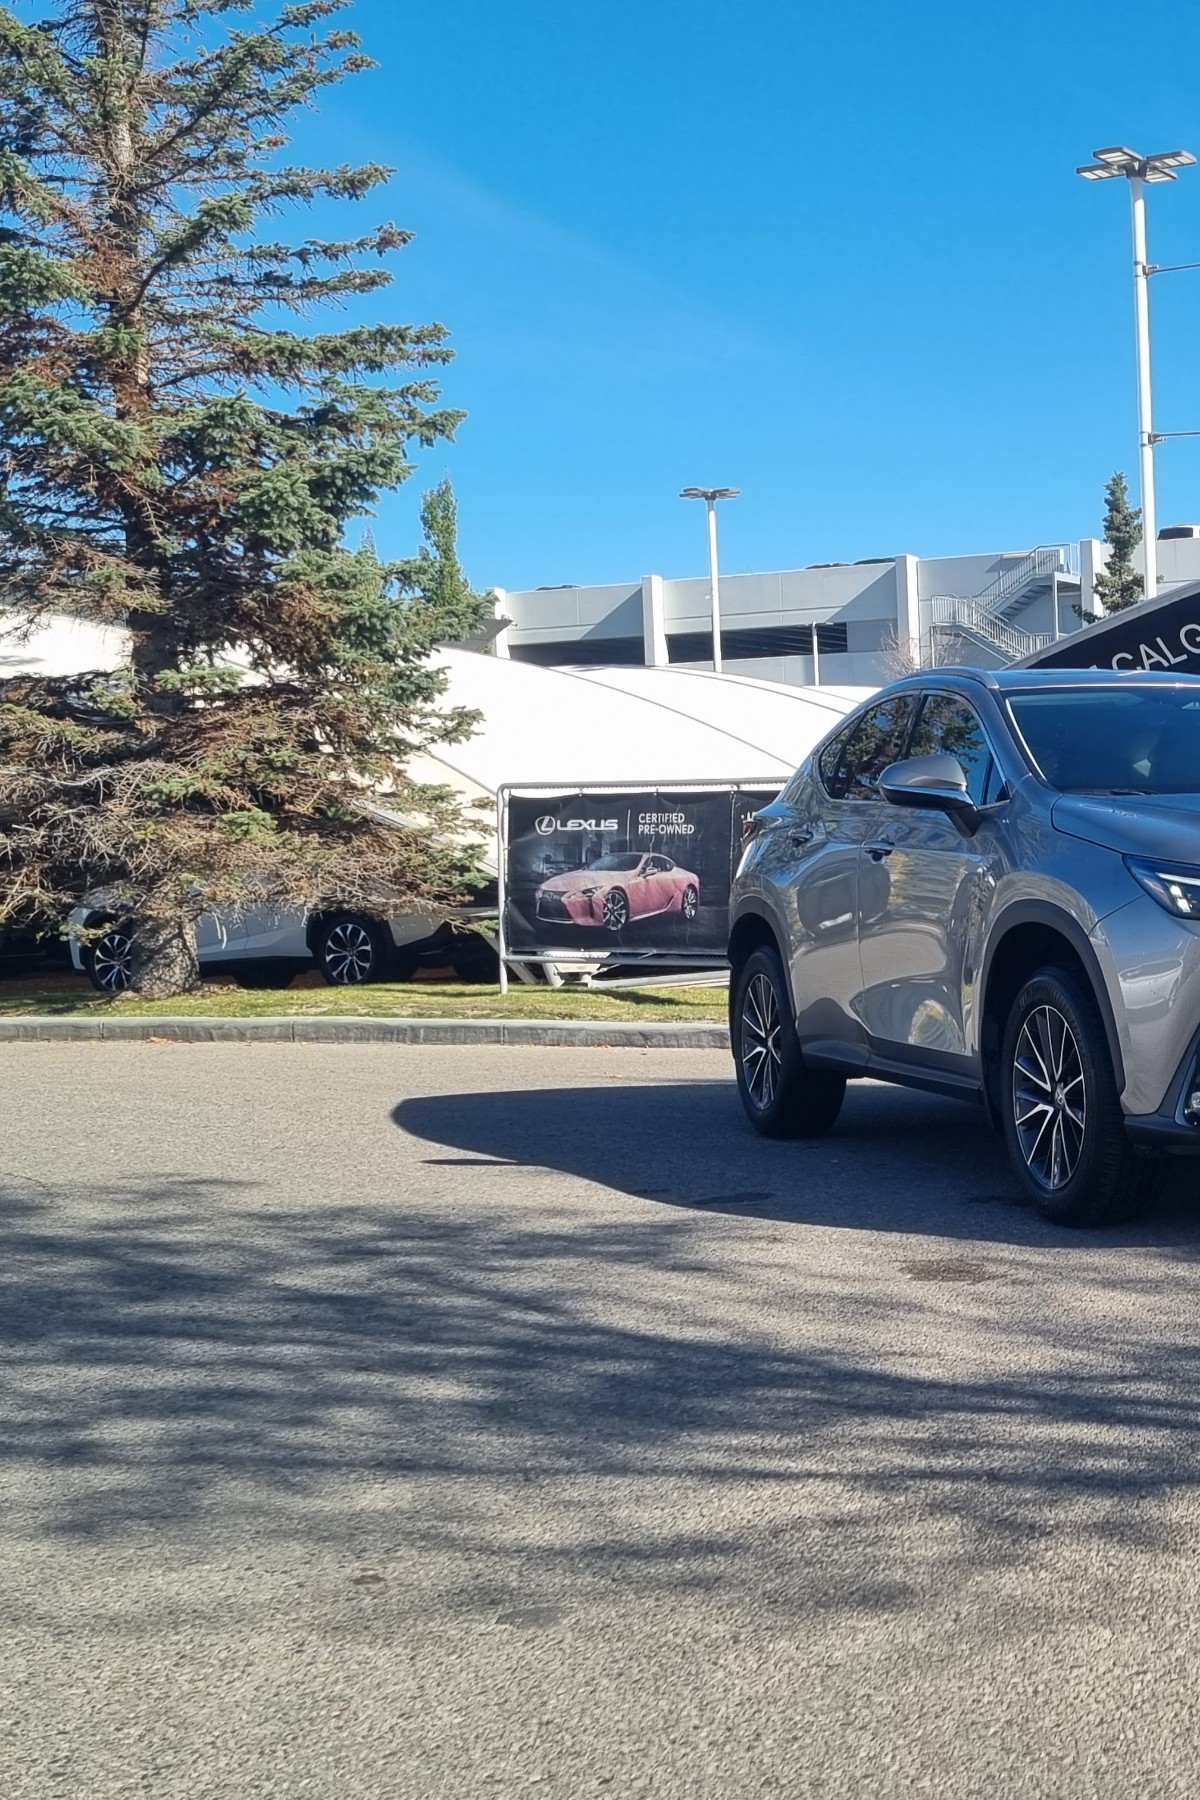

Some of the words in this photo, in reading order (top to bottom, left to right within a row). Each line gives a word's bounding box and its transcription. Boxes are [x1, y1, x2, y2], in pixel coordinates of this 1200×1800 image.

[638, 812, 685, 824] CERTIFIED
[556, 818, 619, 831] LEXUS
[638, 824, 695, 835] PRE-OWNED
